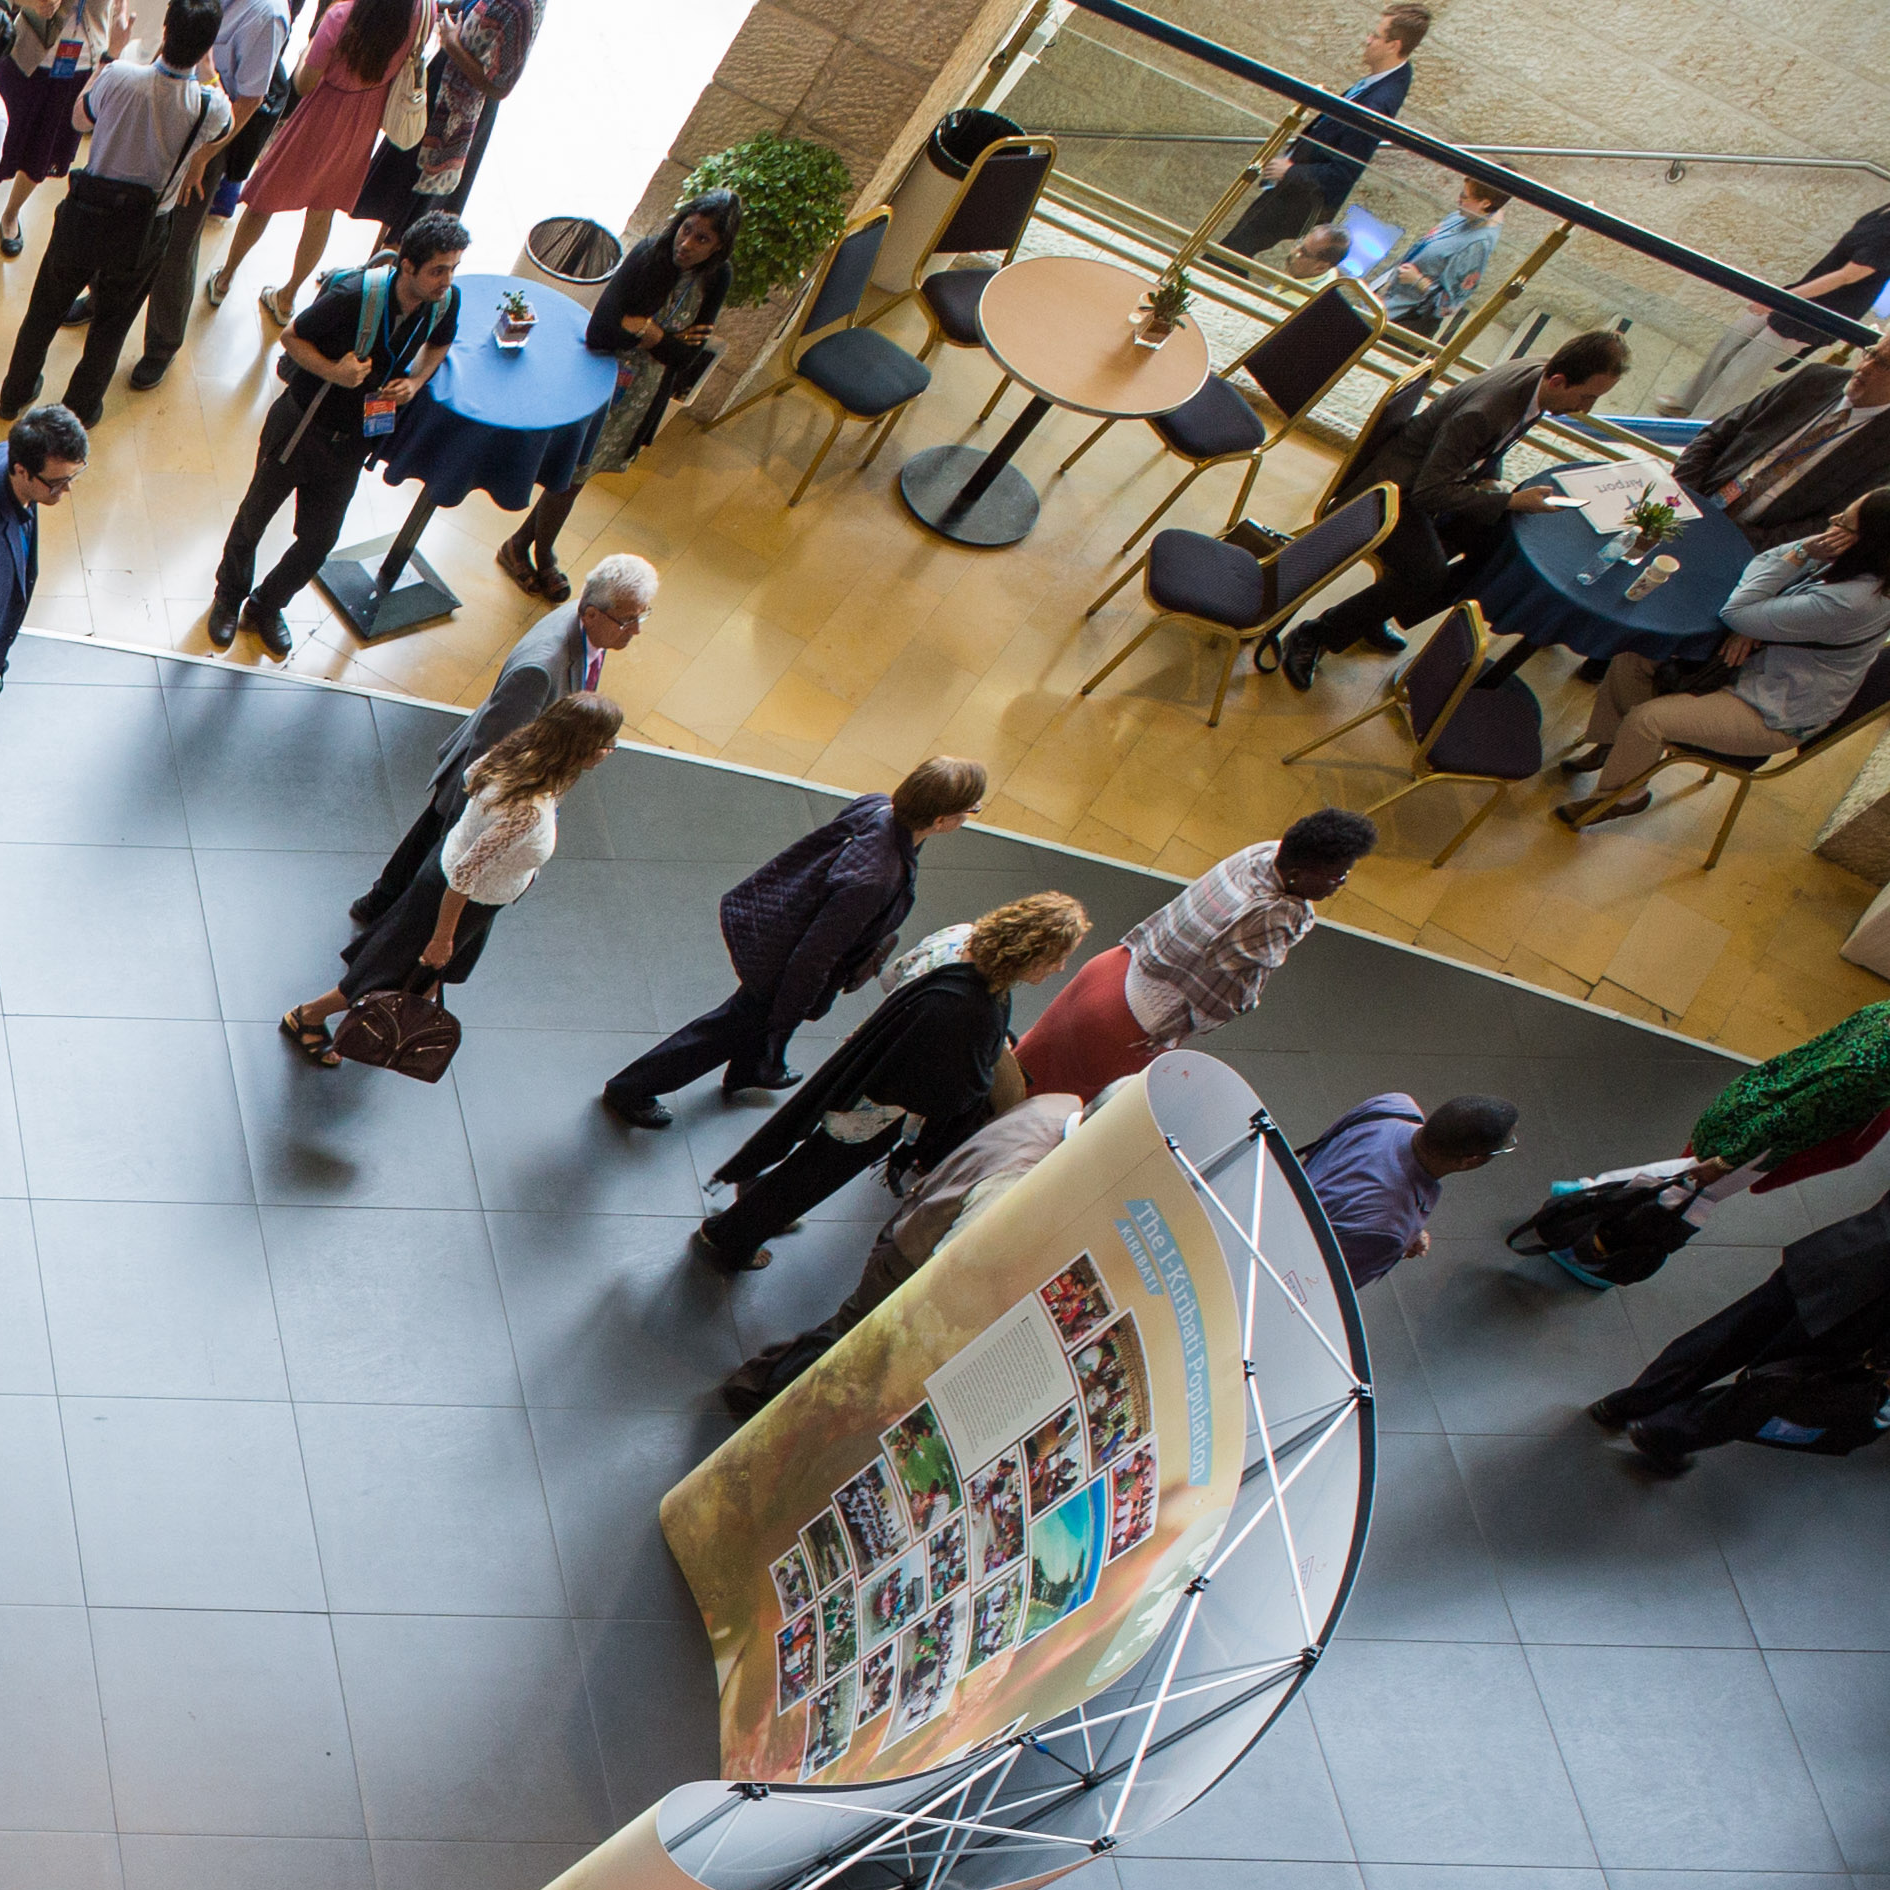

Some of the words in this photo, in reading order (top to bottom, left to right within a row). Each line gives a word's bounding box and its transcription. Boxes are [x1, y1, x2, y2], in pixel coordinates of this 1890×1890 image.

[1595, 477, 1644, 494] Airport
[1120, 1226, 1159, 1292] KIRIBATI
[1136, 1201, 1166, 1250] The
[1159, 1249, 1198, 1349] I-Kiribati
[1188, 1355, 1209, 1480] Population
